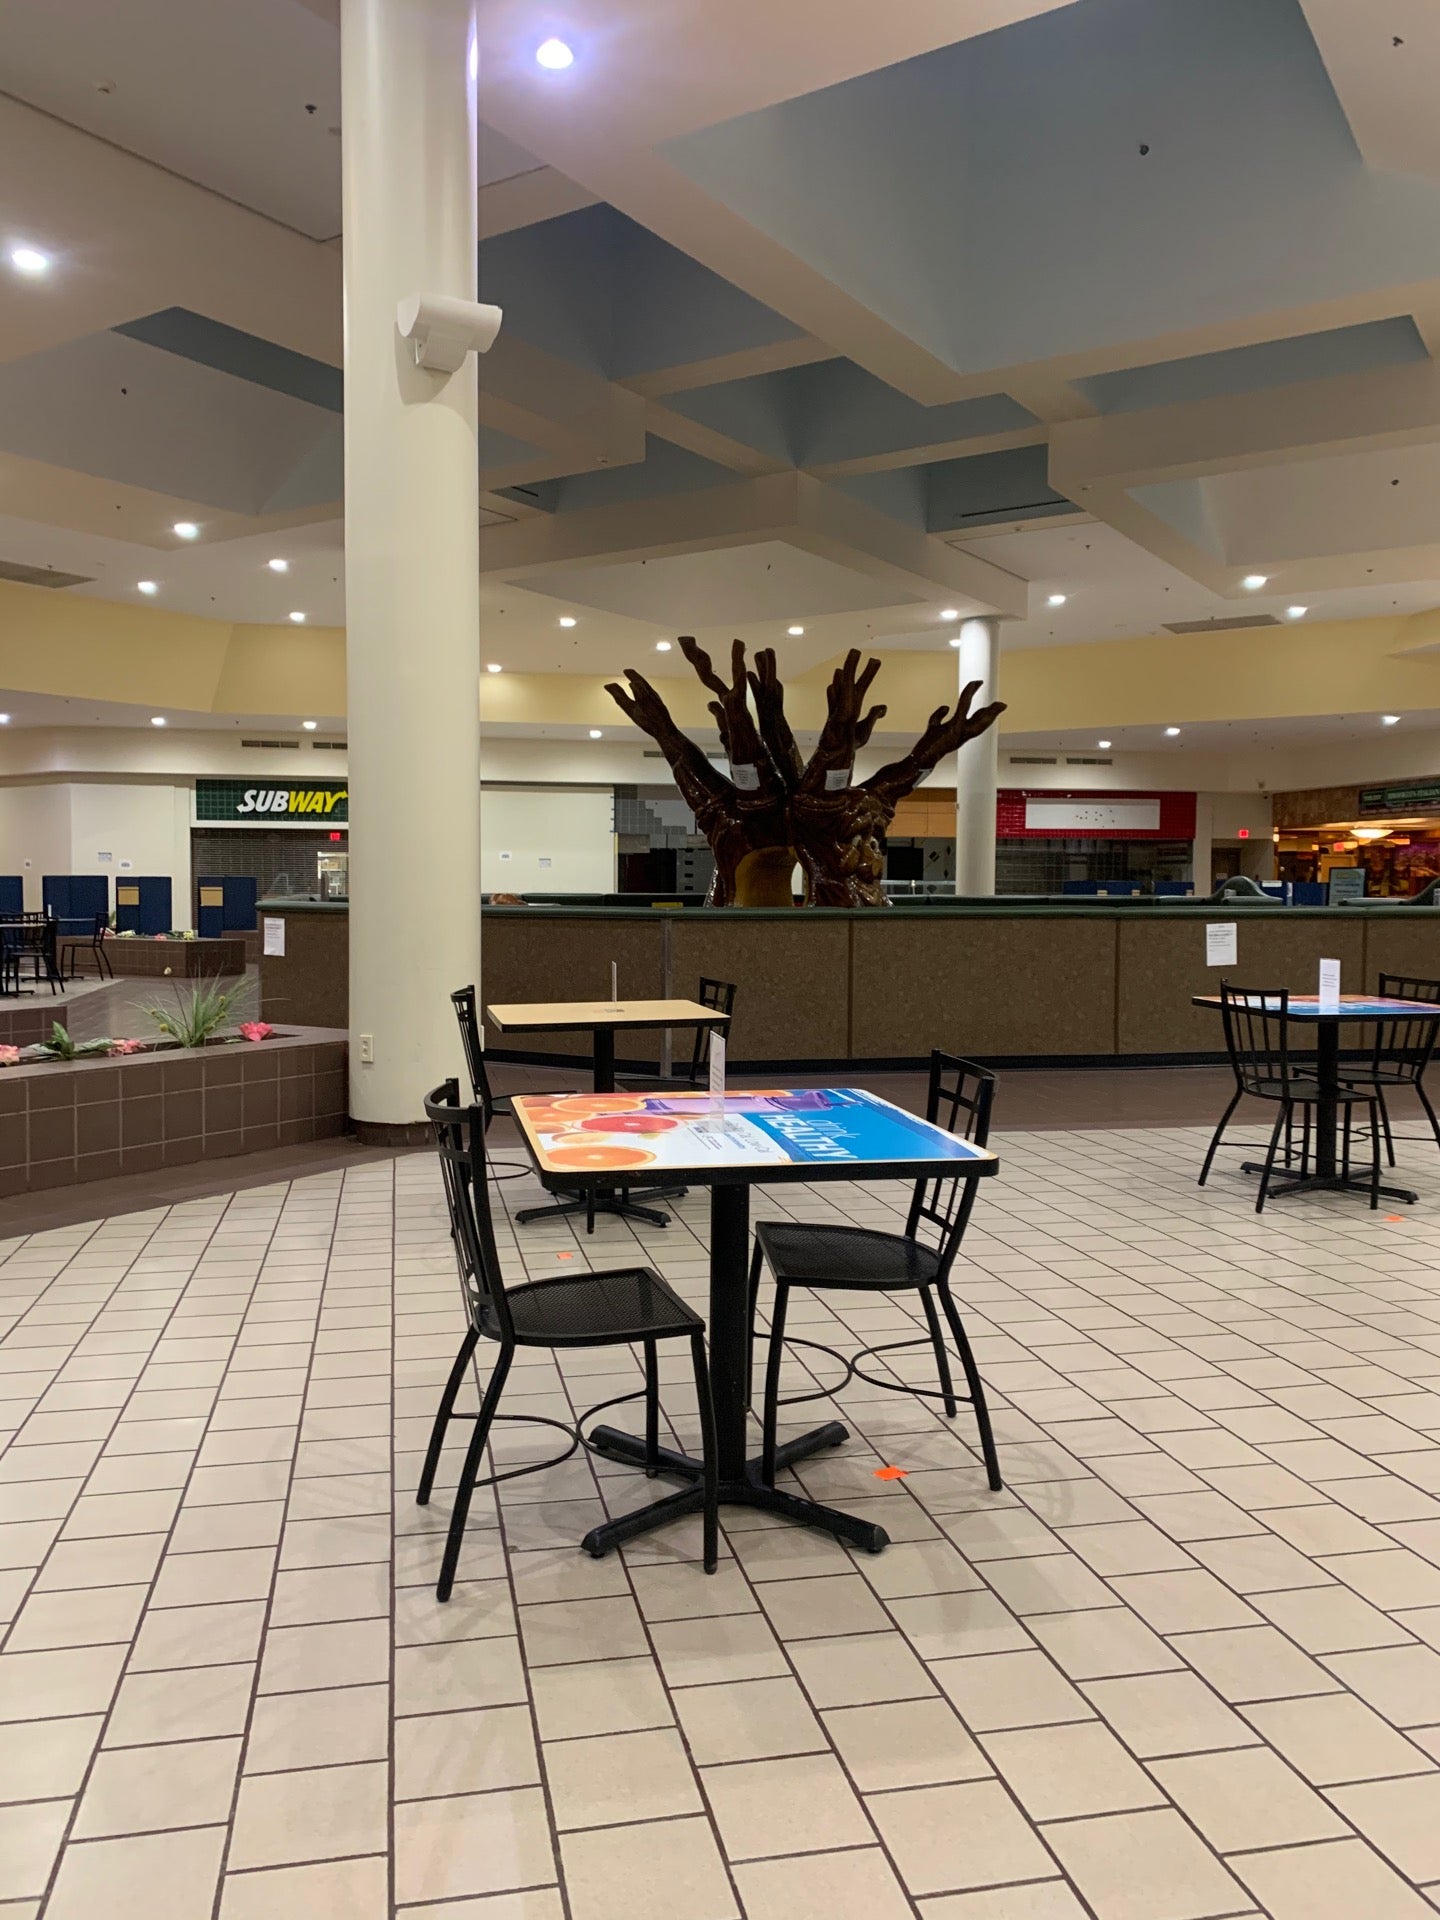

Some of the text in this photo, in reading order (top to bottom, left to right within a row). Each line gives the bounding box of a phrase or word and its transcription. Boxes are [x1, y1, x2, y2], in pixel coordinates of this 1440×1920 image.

[236, 789, 348, 813] SUBWAY
[759, 1114, 859, 1159] HEALTHY
[806, 1120, 861, 1139] drink
